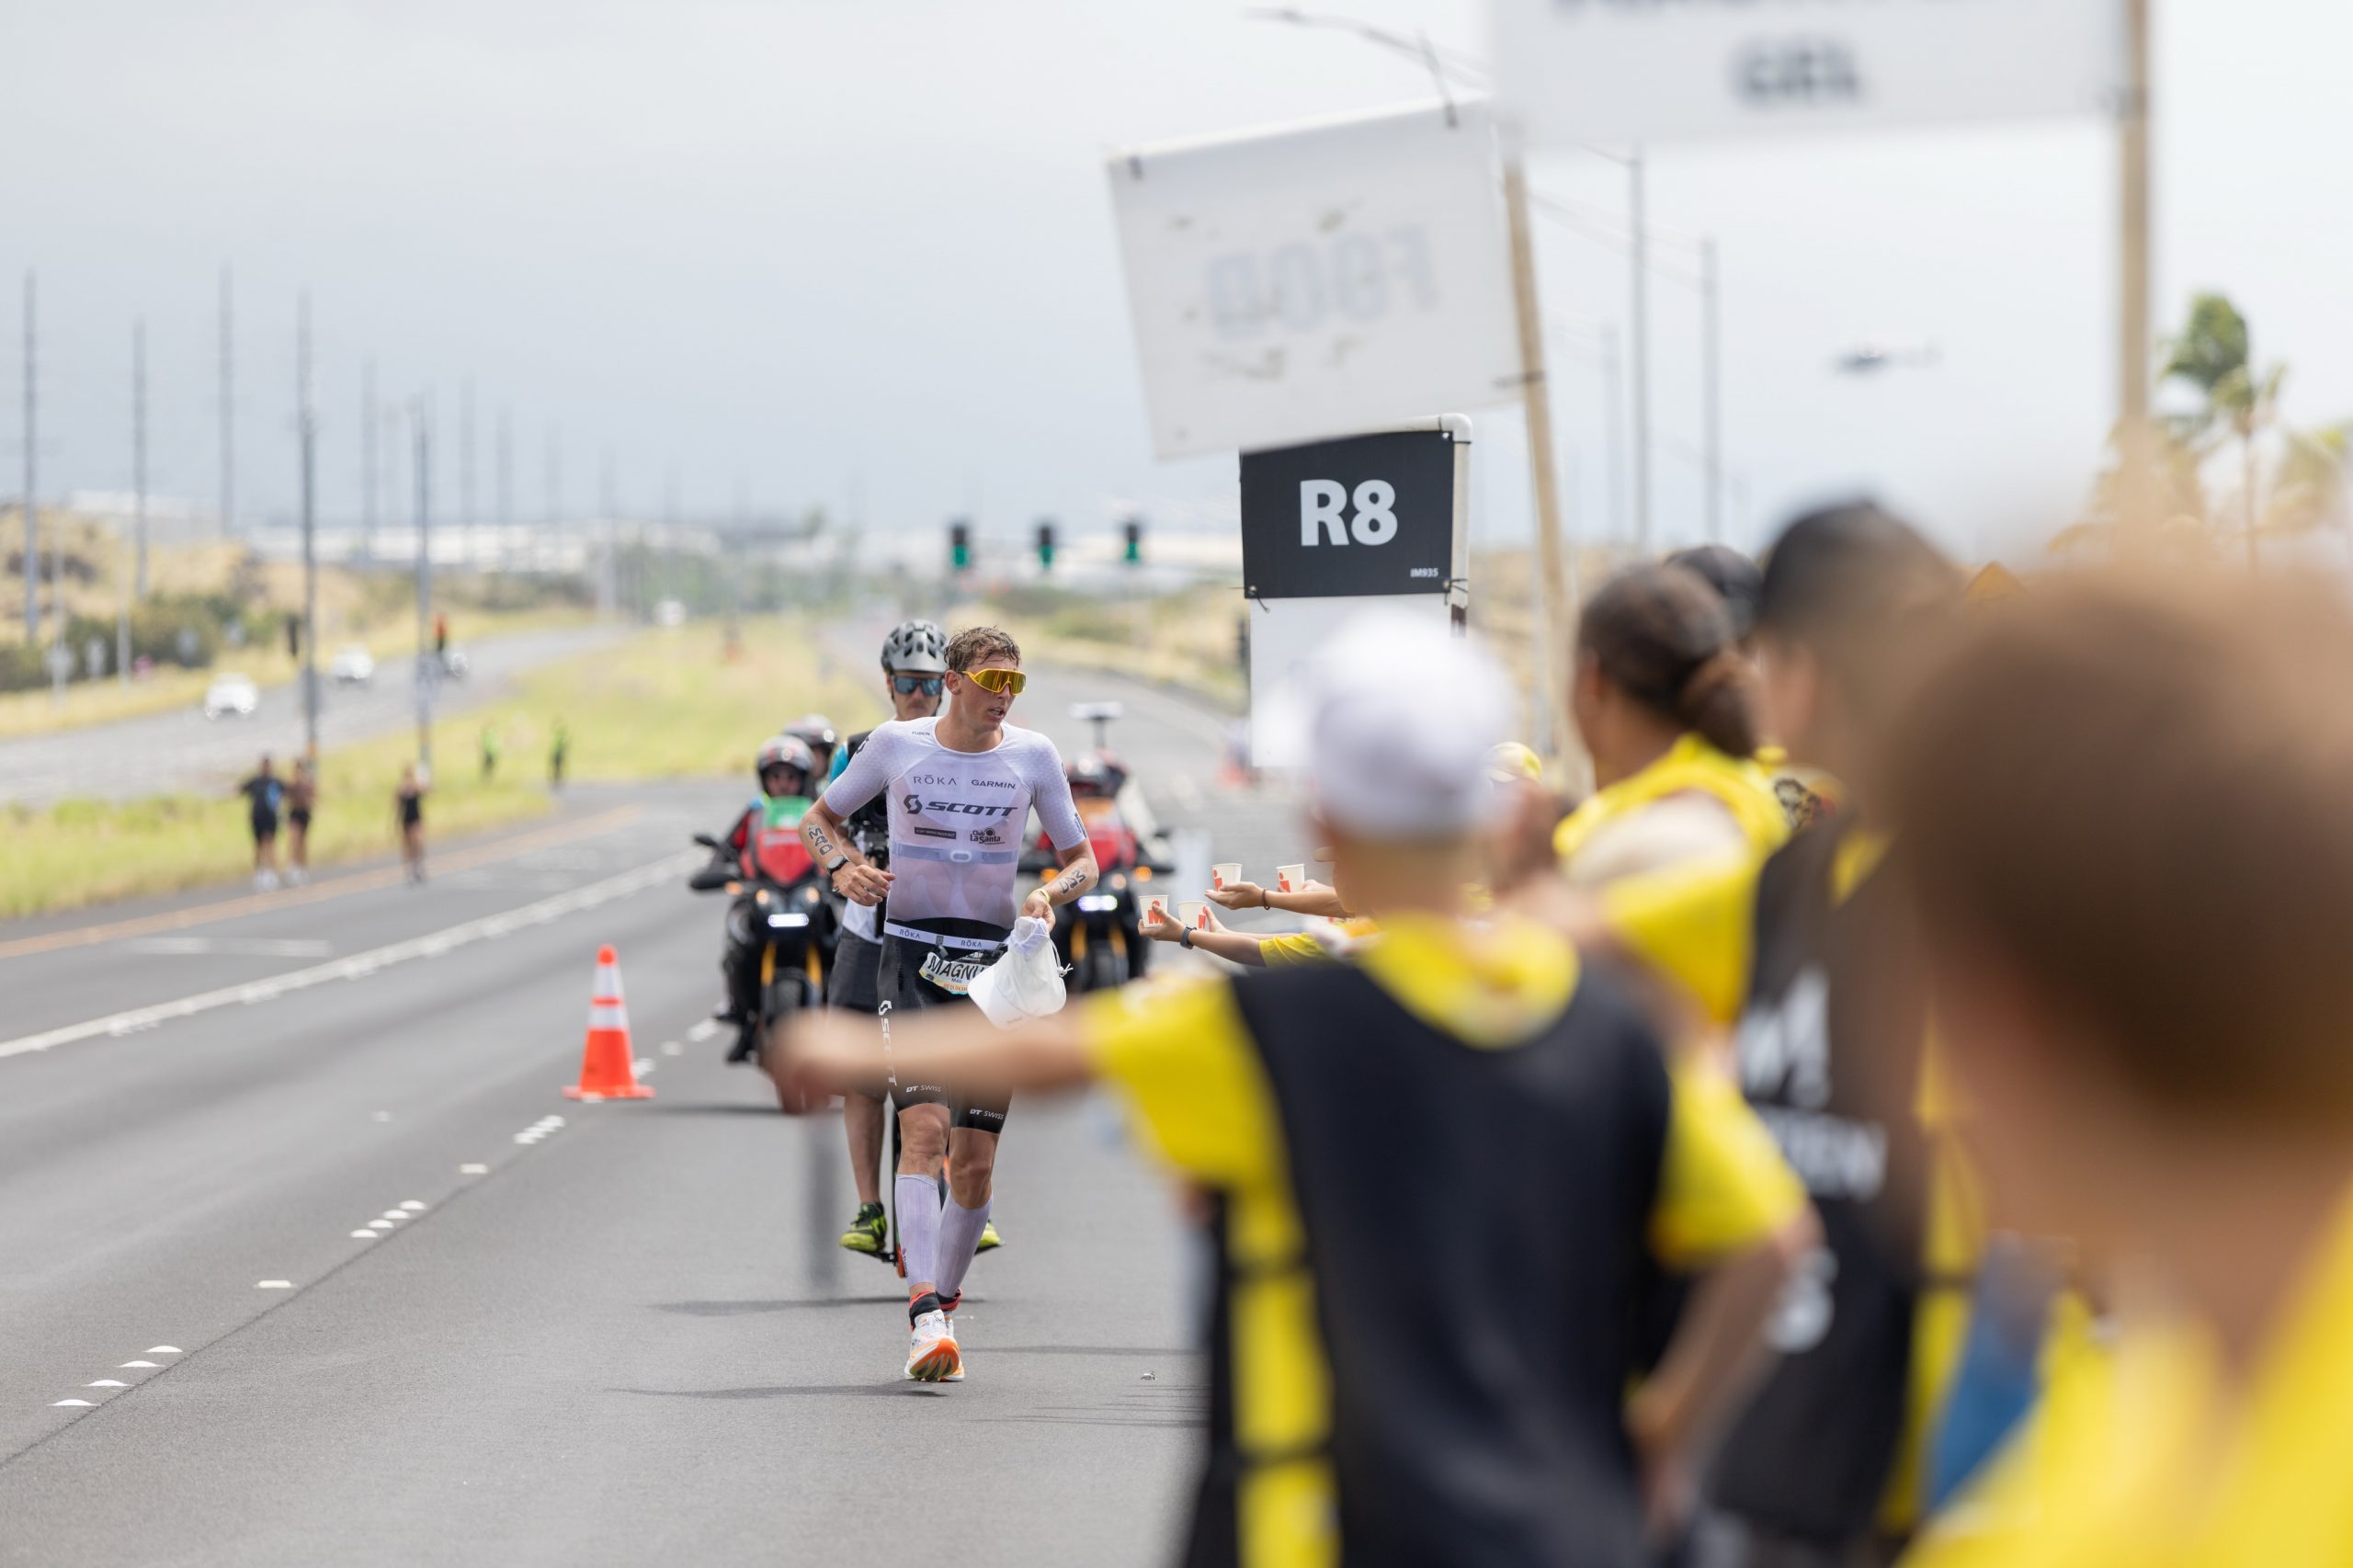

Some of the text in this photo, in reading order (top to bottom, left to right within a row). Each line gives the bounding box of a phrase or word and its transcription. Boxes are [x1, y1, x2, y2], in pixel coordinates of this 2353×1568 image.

[1733, 35, 1862, 106] GEL
[1300, 479, 1398, 546] R8
[971, 778, 1016, 790] GARMIN
[925, 801, 1018, 817] SCOTT
[905, 1085, 919, 1093] DT
[983, 1110, 1005, 1119] SWISS
